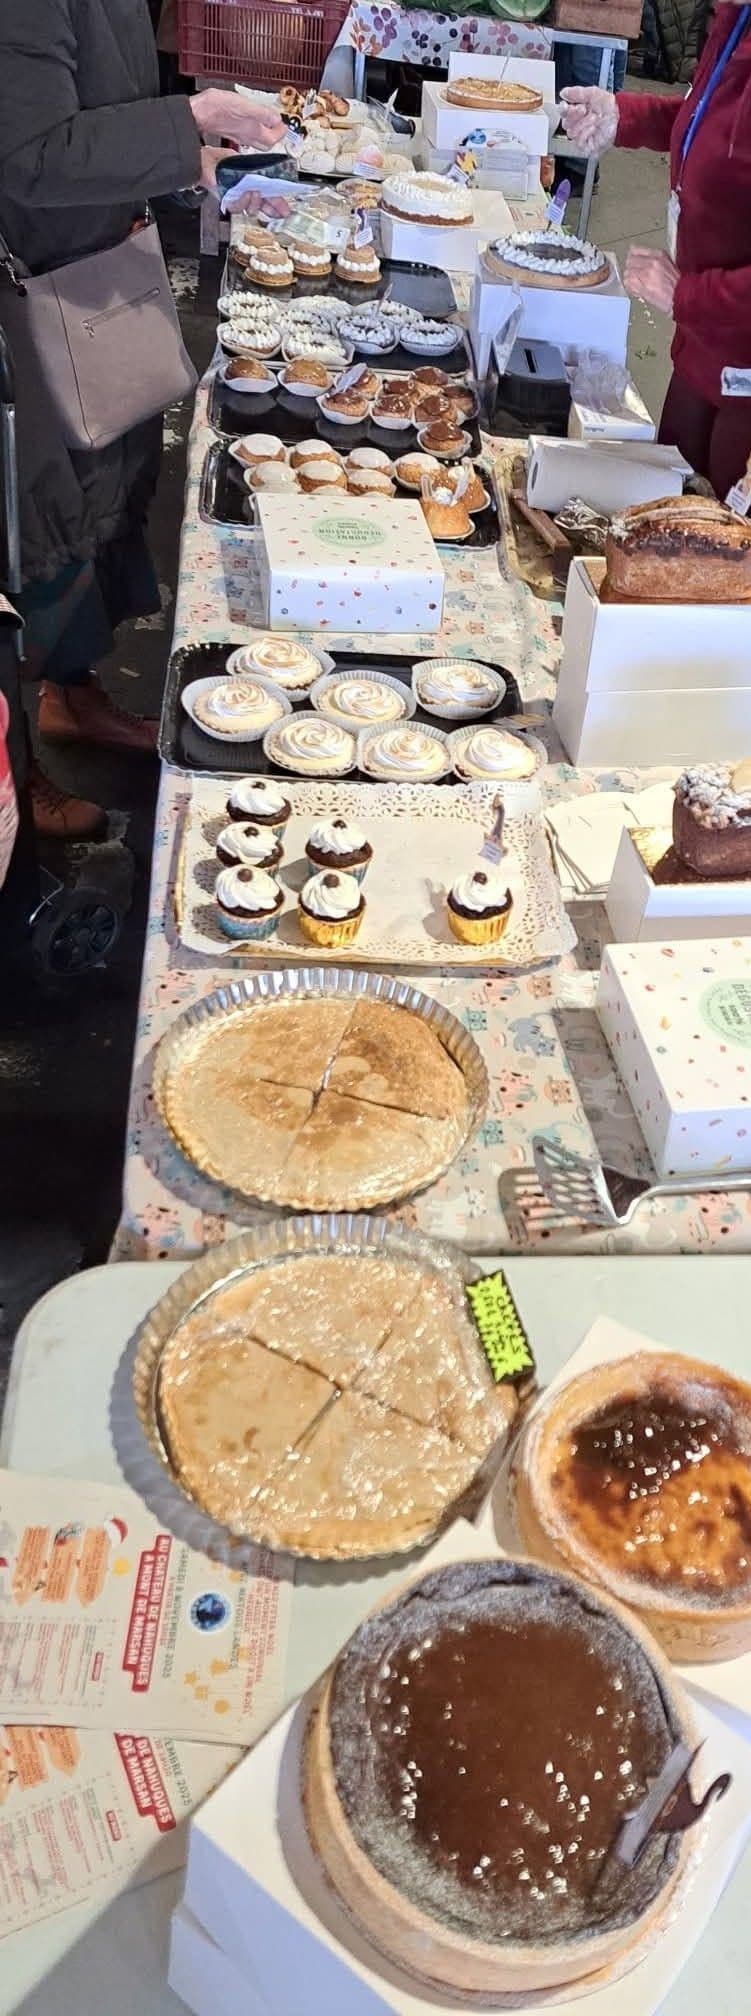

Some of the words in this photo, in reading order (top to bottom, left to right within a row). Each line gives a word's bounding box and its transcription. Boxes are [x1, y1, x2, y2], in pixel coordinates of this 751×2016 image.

[159, 1538, 169, 1552] AU
[140, 1565, 153, 1596] MONT
[136, 1599, 147, 1614] DE
[149, 1606, 160, 1621] DE
[127, 1615, 145, 1665] MARSAN
[137, 1622, 157, 1685] NAHUQUES
[121, 1739, 133, 1755] DE
[137, 1739, 150, 1757] DE
[126, 1758, 151, 1809] MARSAN
[142, 1757, 171, 1823] NAHUQUES
